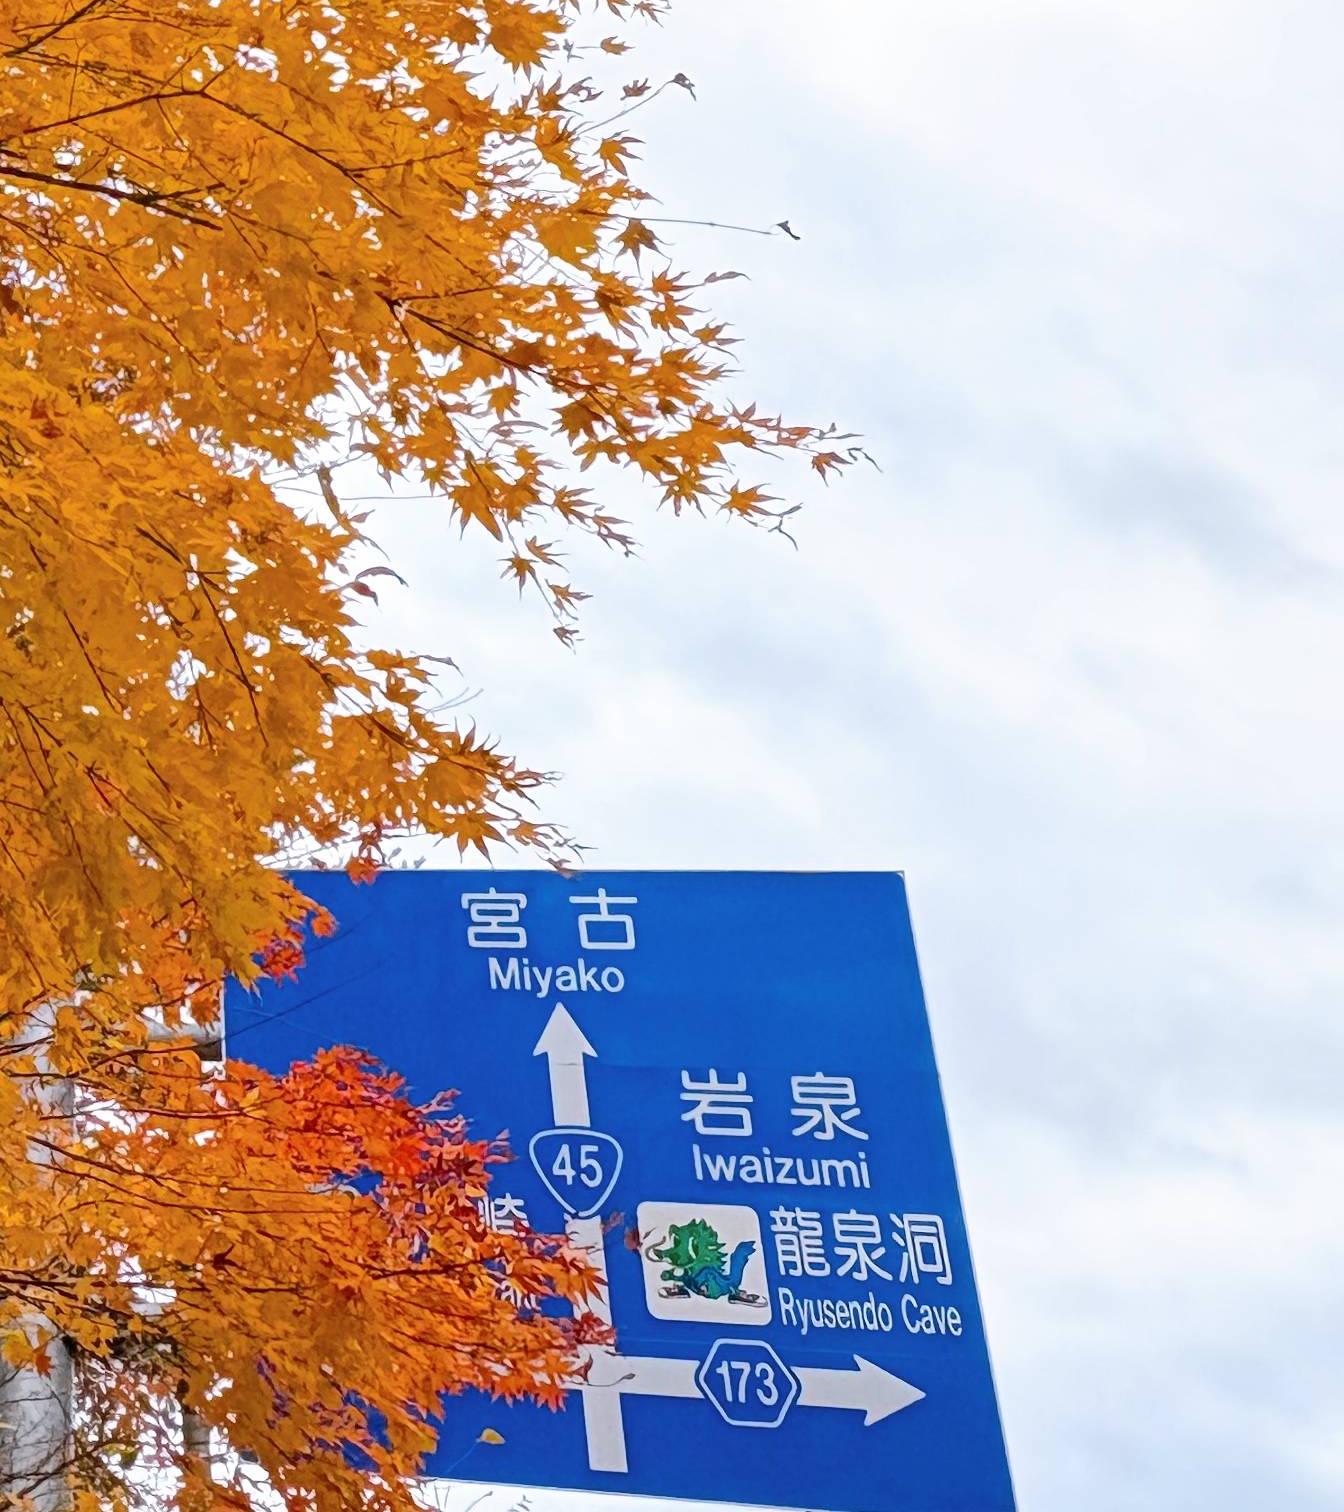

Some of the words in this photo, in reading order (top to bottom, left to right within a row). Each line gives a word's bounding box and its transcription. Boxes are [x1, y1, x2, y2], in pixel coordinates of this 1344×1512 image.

[460, 886, 638, 950] 宮古
[488, 956, 625, 998] Miyako
[679, 1067, 870, 1141] 岩泉
[552, 1143, 603, 1188] 45
[692, 1143, 871, 1189] Iwaizumi
[769, 1205, 953, 1286] 龍泉洞
[778, 1287, 893, 1336] Ryusendo
[901, 1293, 962, 1336] Cave
[715, 1360, 779, 1406] 173
